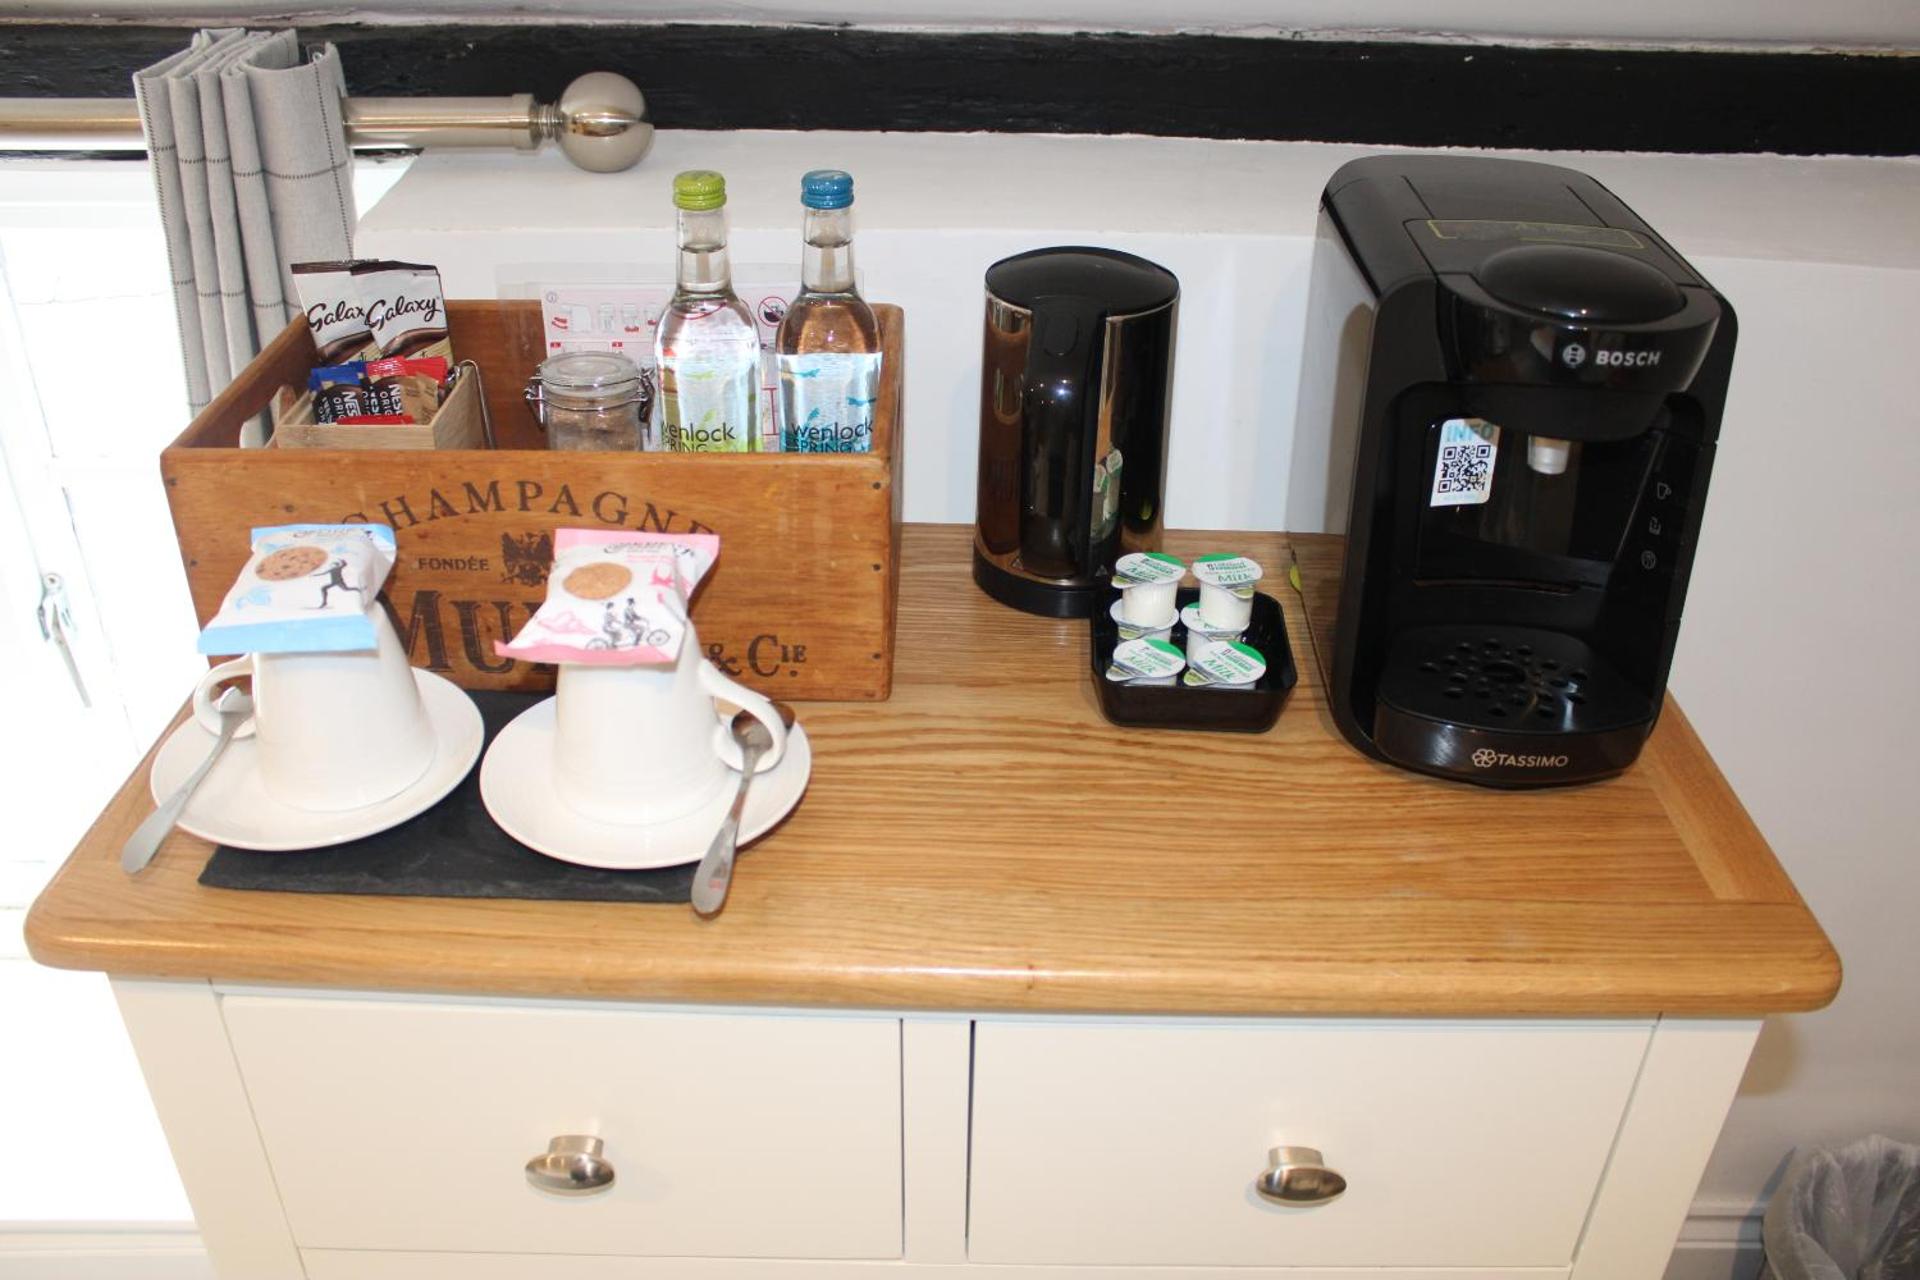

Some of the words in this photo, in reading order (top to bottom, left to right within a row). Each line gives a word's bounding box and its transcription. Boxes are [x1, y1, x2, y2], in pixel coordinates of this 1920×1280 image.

[307, 302, 365, 332] Galax
[364, 295, 442, 331] Galaxy
[1595, 350, 1661, 366] BOSCH
[418, 555, 490, 571] FONDÉE
[703, 643, 742, 676] &
[1497, 754, 1569, 768] TASSIMO
